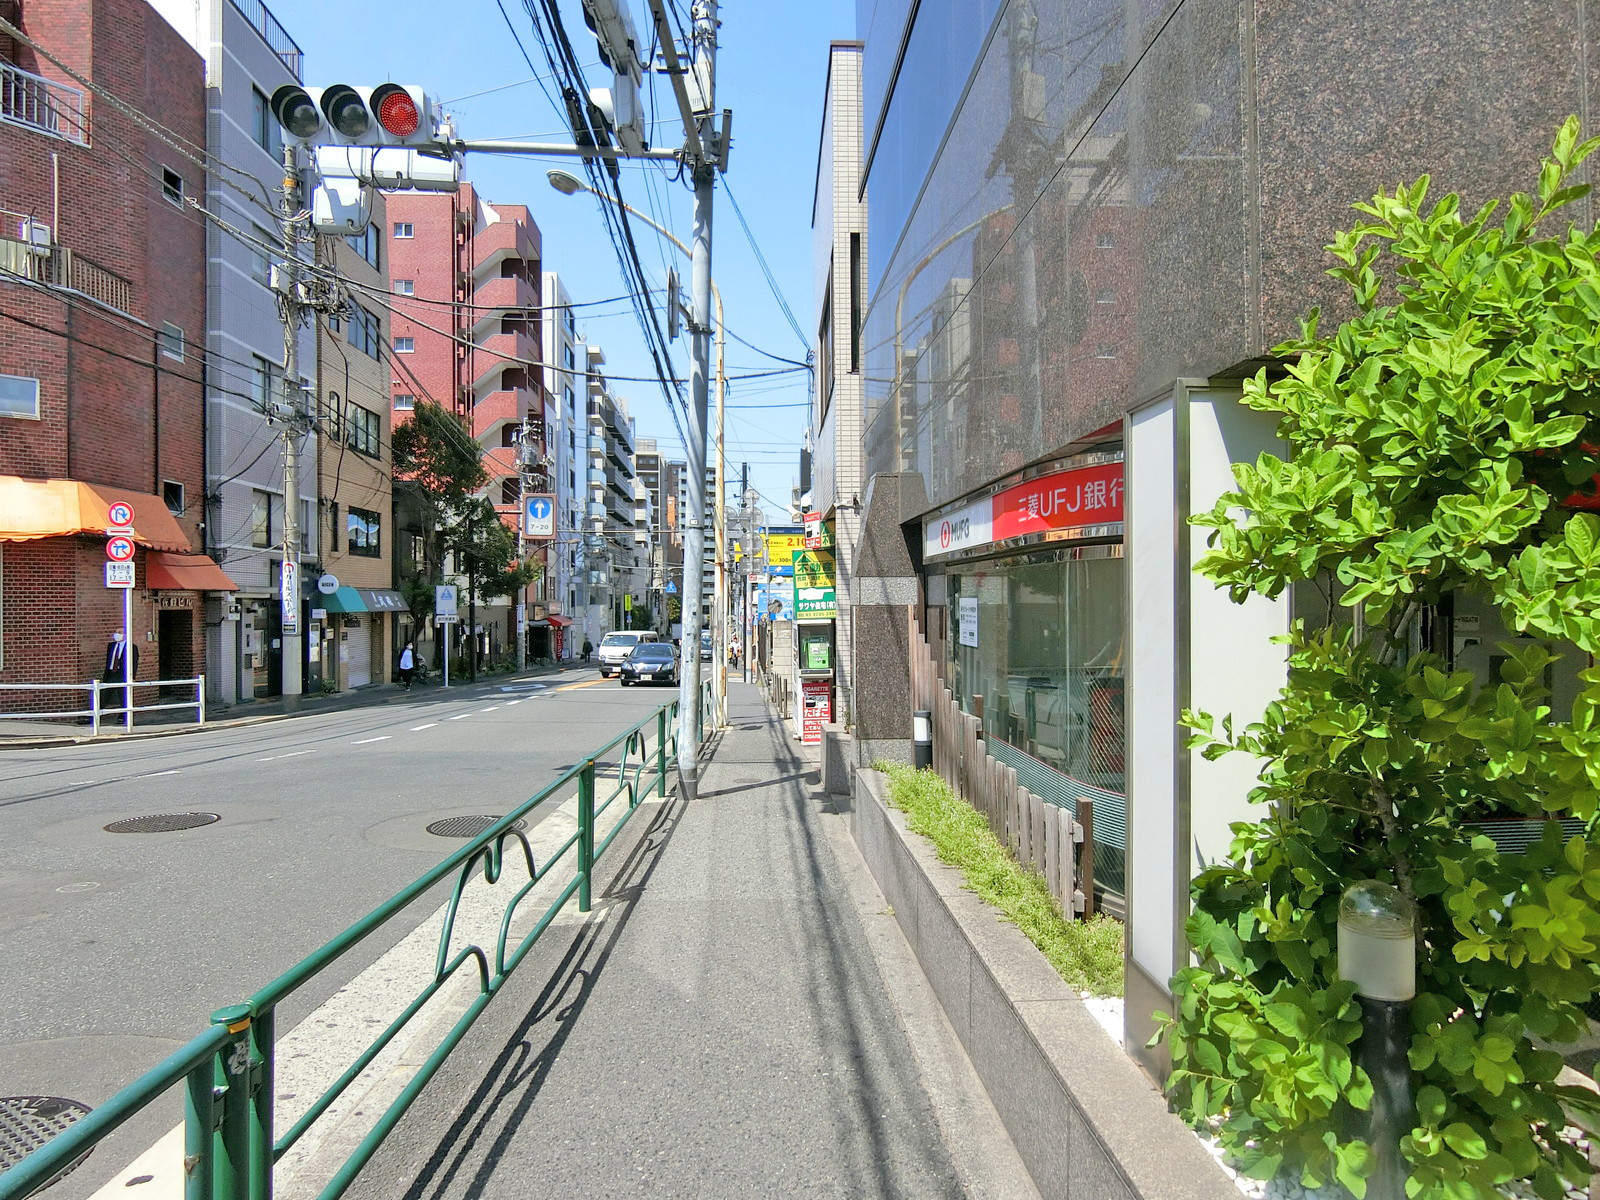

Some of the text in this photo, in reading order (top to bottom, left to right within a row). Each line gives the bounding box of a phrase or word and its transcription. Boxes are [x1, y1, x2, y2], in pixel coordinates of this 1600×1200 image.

[1018, 478, 1124, 523] 三菱UFJ銀行
[951, 517, 970, 543] MUFG
[797, 561, 833, 573] 不動産
[804, 708, 829, 717] たばこ
